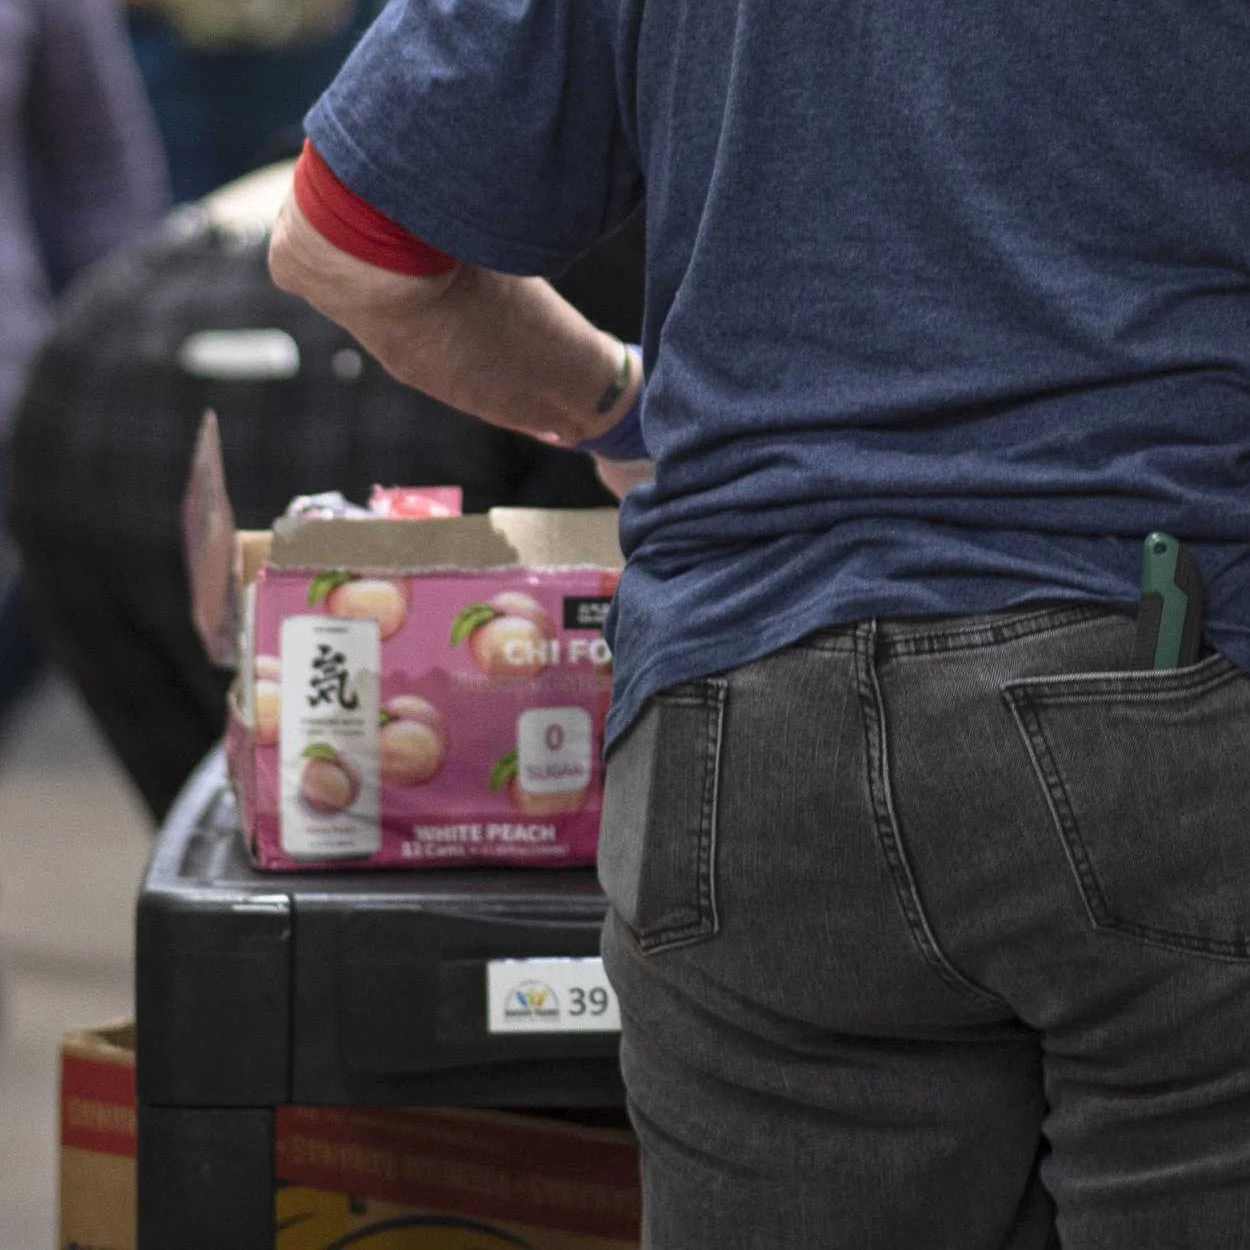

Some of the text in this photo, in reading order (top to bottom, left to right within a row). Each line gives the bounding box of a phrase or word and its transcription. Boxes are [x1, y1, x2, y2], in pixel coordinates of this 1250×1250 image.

[504, 638, 561, 665] CHI
[545, 723, 565, 751] 0
[413, 823, 556, 843] WHITE PEACH
[569, 986, 609, 1017] 39
